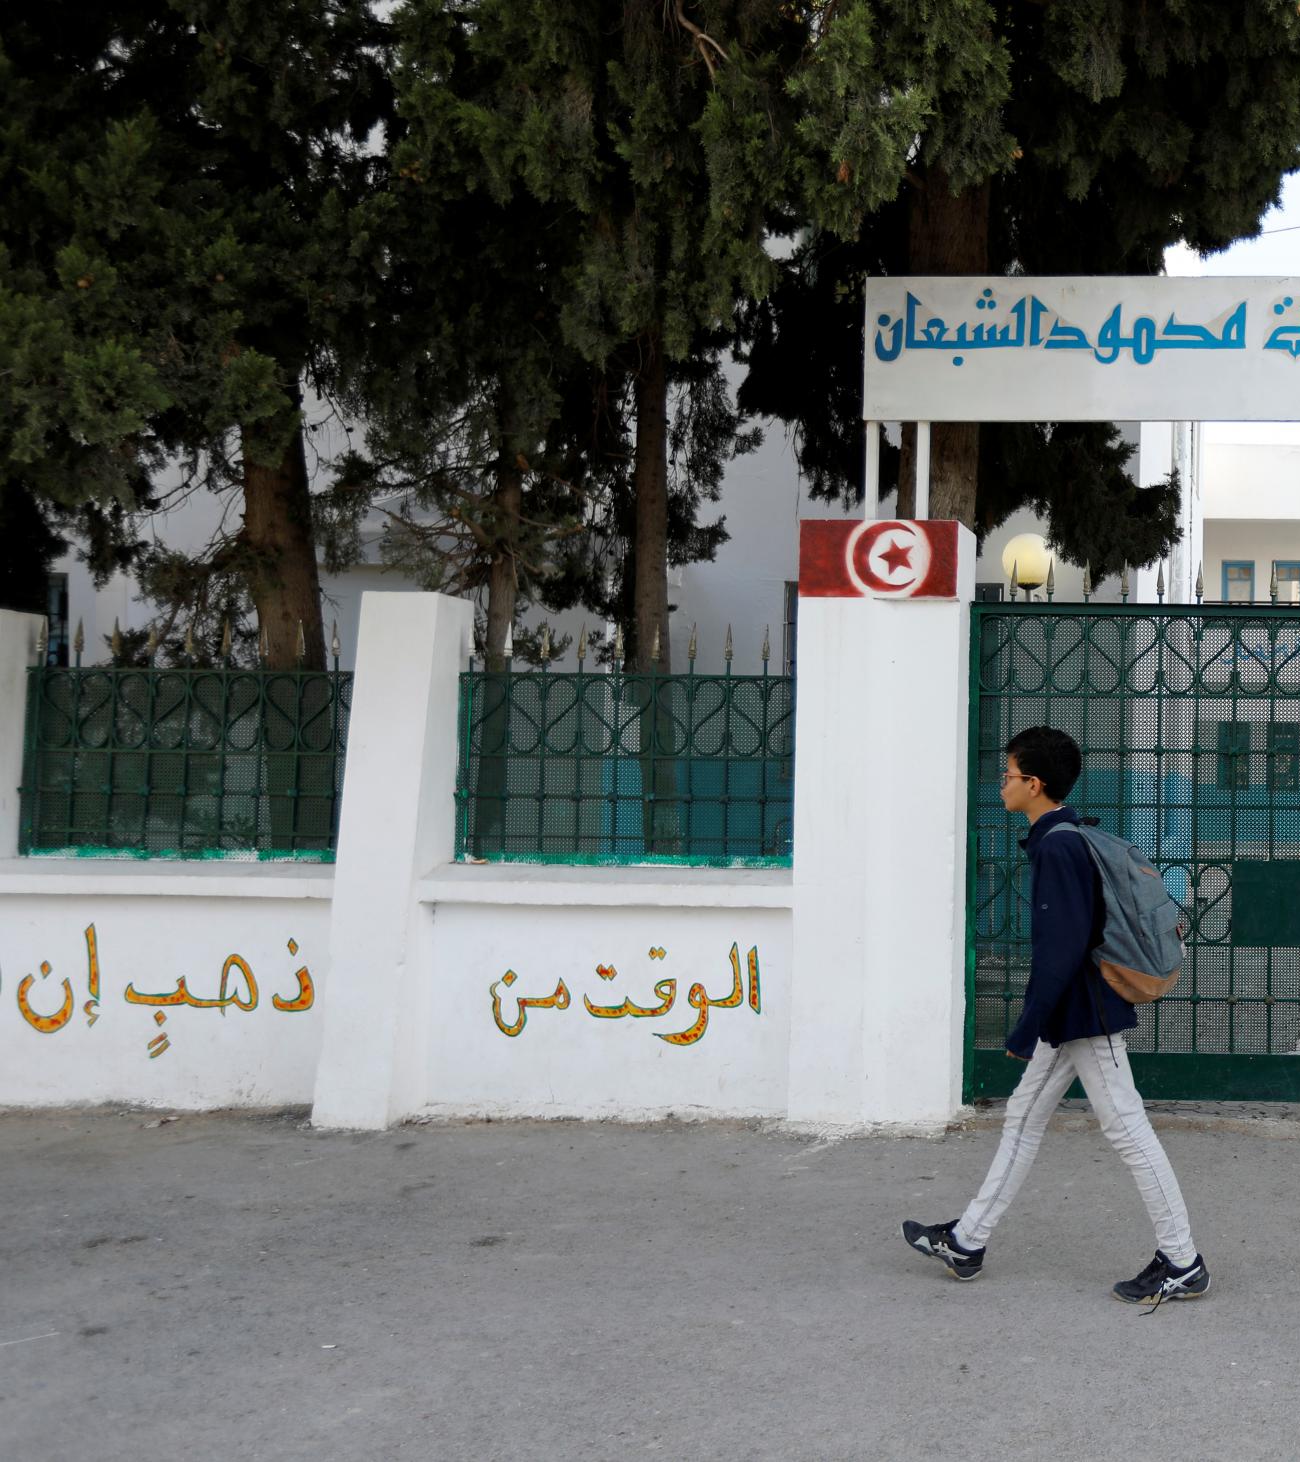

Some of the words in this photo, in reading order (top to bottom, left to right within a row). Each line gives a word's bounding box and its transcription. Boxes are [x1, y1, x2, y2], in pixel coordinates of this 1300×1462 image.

[873, 287, 1048, 367] الشبعان
[1043, 301, 1248, 366] محمود
[16, 921, 101, 1034] إن
[489, 968, 572, 1037] من
[583, 941, 762, 1047] الوقت
